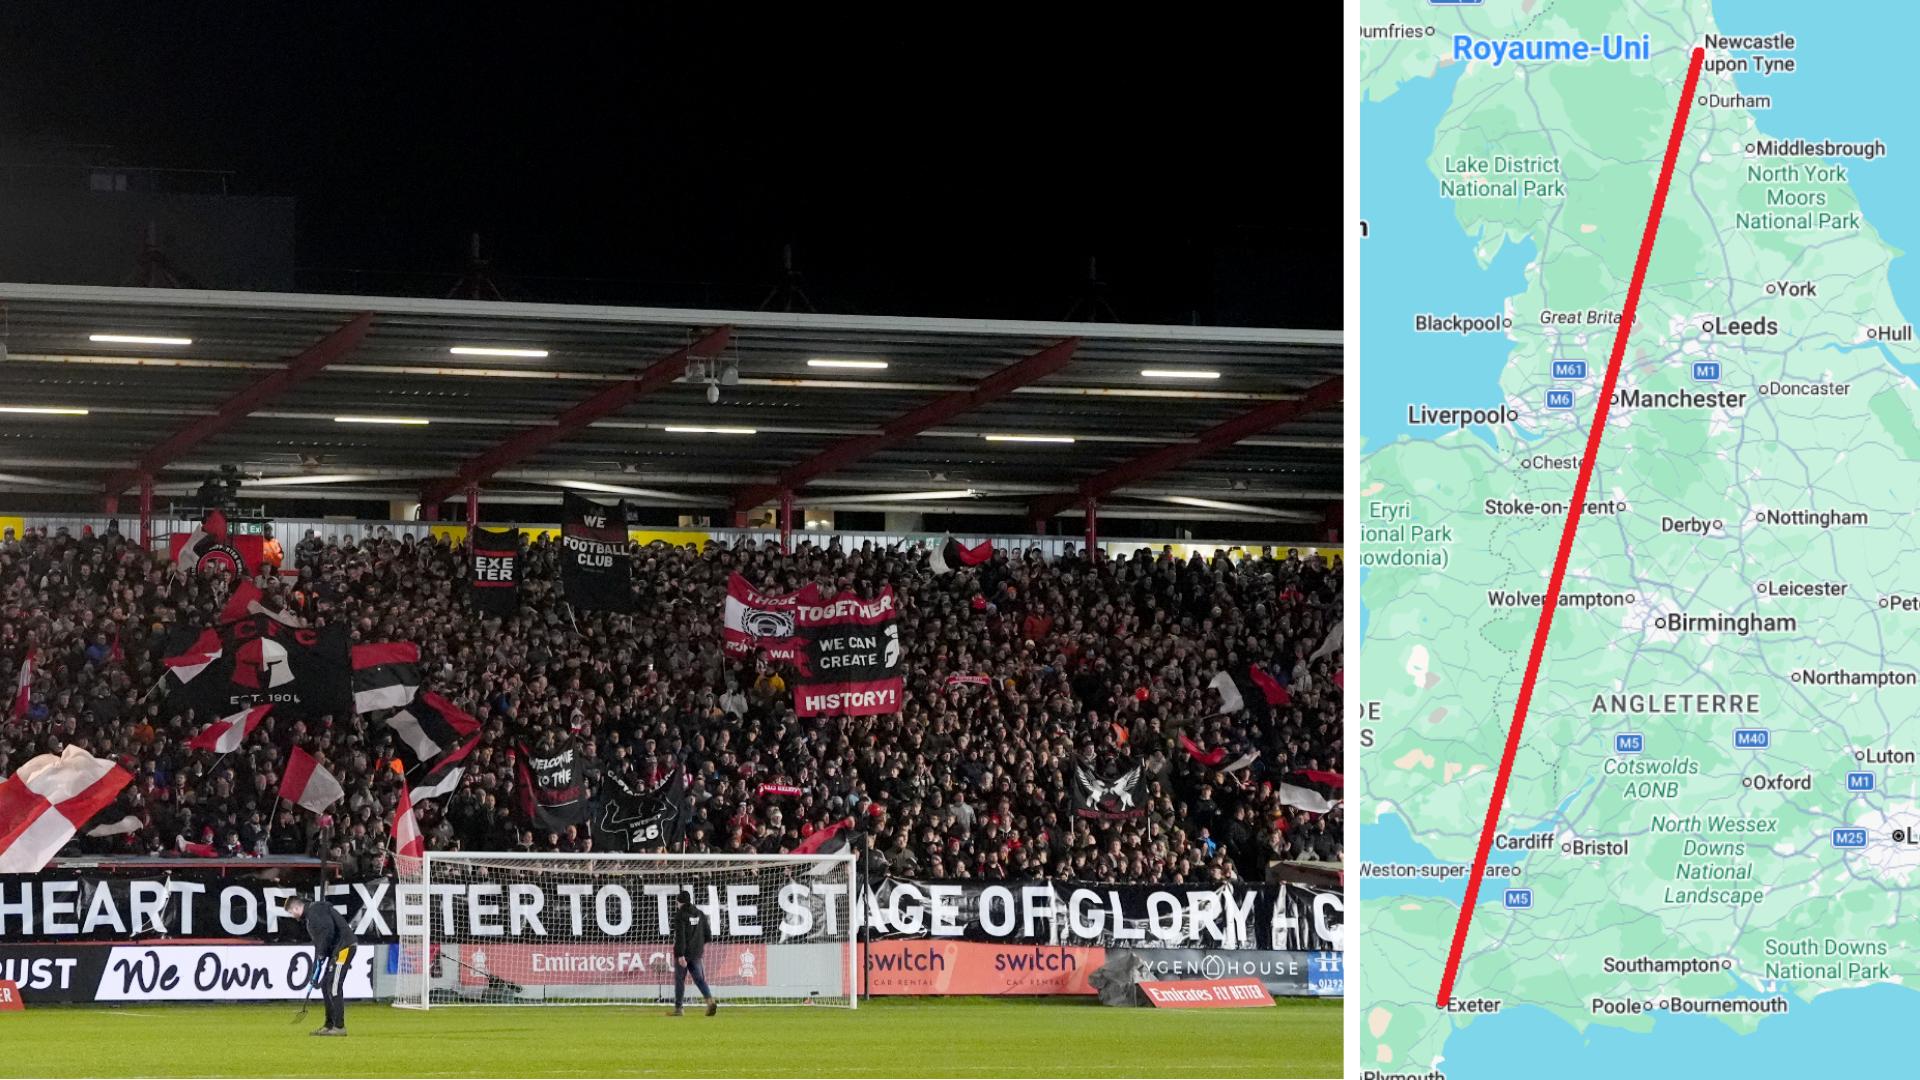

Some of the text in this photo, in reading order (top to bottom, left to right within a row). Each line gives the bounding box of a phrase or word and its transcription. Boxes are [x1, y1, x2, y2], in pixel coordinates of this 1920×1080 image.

[1706, 34, 1794, 49] Newcastle
[1455, 34, 1648, 67] Royaume-Uni
[1706, 57, 1794, 74] upon Tyne
[1710, 94, 1769, 107] Durham
[1758, 141, 1884, 159] Middlesbrough
[1447, 157, 1558, 172] Lake District
[1749, 166, 1845, 181] North York
[1442, 181, 1563, 196] National Park
[1768, 190, 1824, 205] Moors
[1737, 213, 1858, 228] National Park
[1778, 282, 1815, 296] York
[1417, 315, 1499, 333] Blackpool
[1541, 311, 1636, 323] Great Brita
[1716, 317, 1777, 335] Leeds
[1879, 326, 1911, 340] Hull
[1555, 363, 1583, 377] M61
[1696, 365, 1716, 378] M1
[1771, 382, 1849, 394] Doncaster
[1549, 393, 1571, 406] M6
[1621, 389, 1746, 407] Manchester
[1410, 405, 1504, 428] Liverpool
[1534, 456, 1582, 468] Chest
[1371, 503, 1408, 521] Eryri
[1486, 500, 1614, 514] Stoke-on-rent
[583, 514, 607, 529] WE
[1663, 517, 1710, 535] Derby
[1768, 510, 1867, 528] Nottingham
[1412, 526, 1451, 541] Park
[563, 536, 630, 556] FOOTBALL
[476, 556, 514, 569] EXE
[577, 553, 613, 568] CLUB
[475, 569, 513, 581] TER
[1770, 581, 1847, 595] Leicester
[1489, 591, 1623, 609] Wolverampton
[1891, 596, 1920, 610] Pet
[797, 595, 893, 622] TOGETHER
[1669, 613, 1795, 636] Birmingham
[819, 636, 877, 652] WE CAN
[820, 653, 878, 669] CREATE
[1804, 670, 1915, 687] Northampton
[805, 690, 896, 711] HISTORY!
[1593, 695, 1758, 712] ANGLETERRE
[1619, 737, 1640, 749] M5
[1738, 732, 1765, 745] M40
[529, 749, 574, 771] WELCOME
[1867, 749, 1914, 763] Luton
[1605, 758, 1697, 773] Cotswolds
[551, 768, 572, 787] THE
[1754, 775, 1810, 789] Oxford
[1851, 776, 1870, 789] M1
[1624, 783, 1678, 797] AONB
[1652, 816, 1775, 831] North Wessex
[632, 824, 659, 843] 26
[1835, 832, 1863, 845] M25
[1496, 834, 1553, 849] Cardiff
[1574, 840, 1627, 855] Bristol
[1685, 840, 1744, 855] Downs
[1360, 864, 1511, 879] Weston-super-are
[1677, 864, 1751, 879] National
[1508, 892, 1529, 905] M5
[1665, 888, 1762, 906] Landscape
[0, 881, 206, 936] HEART
[219, 885, 306, 935] OF
[314, 883, 547, 936] EXETER
[557, 884, 632, 936] TO
[643, 884, 764, 936] THE
[777, 882, 964, 937] STAGE
[978, 885, 1054, 936] OF
[1070, 889, 1258, 945] GLORY
[1767, 940, 1886, 954] South Downs
[532, 952, 614, 972] Emirates
[618, 952, 645, 972] FA
[995, 948, 1077, 971] switch
[1605, 957, 1719, 975] Southampton
[114, 950, 180, 994] We
[195, 952, 273, 992] Own
[1228, 961, 1298, 976] HOUSE
[1767, 963, 1888, 978] National Park
[1150, 984, 1265, 1002] Emirates FLY BETTER
[1447, 998, 1500, 1012] Exeter
[1593, 999, 1640, 1013] Poole
[1672, 997, 1786, 1012] Bournemouth
